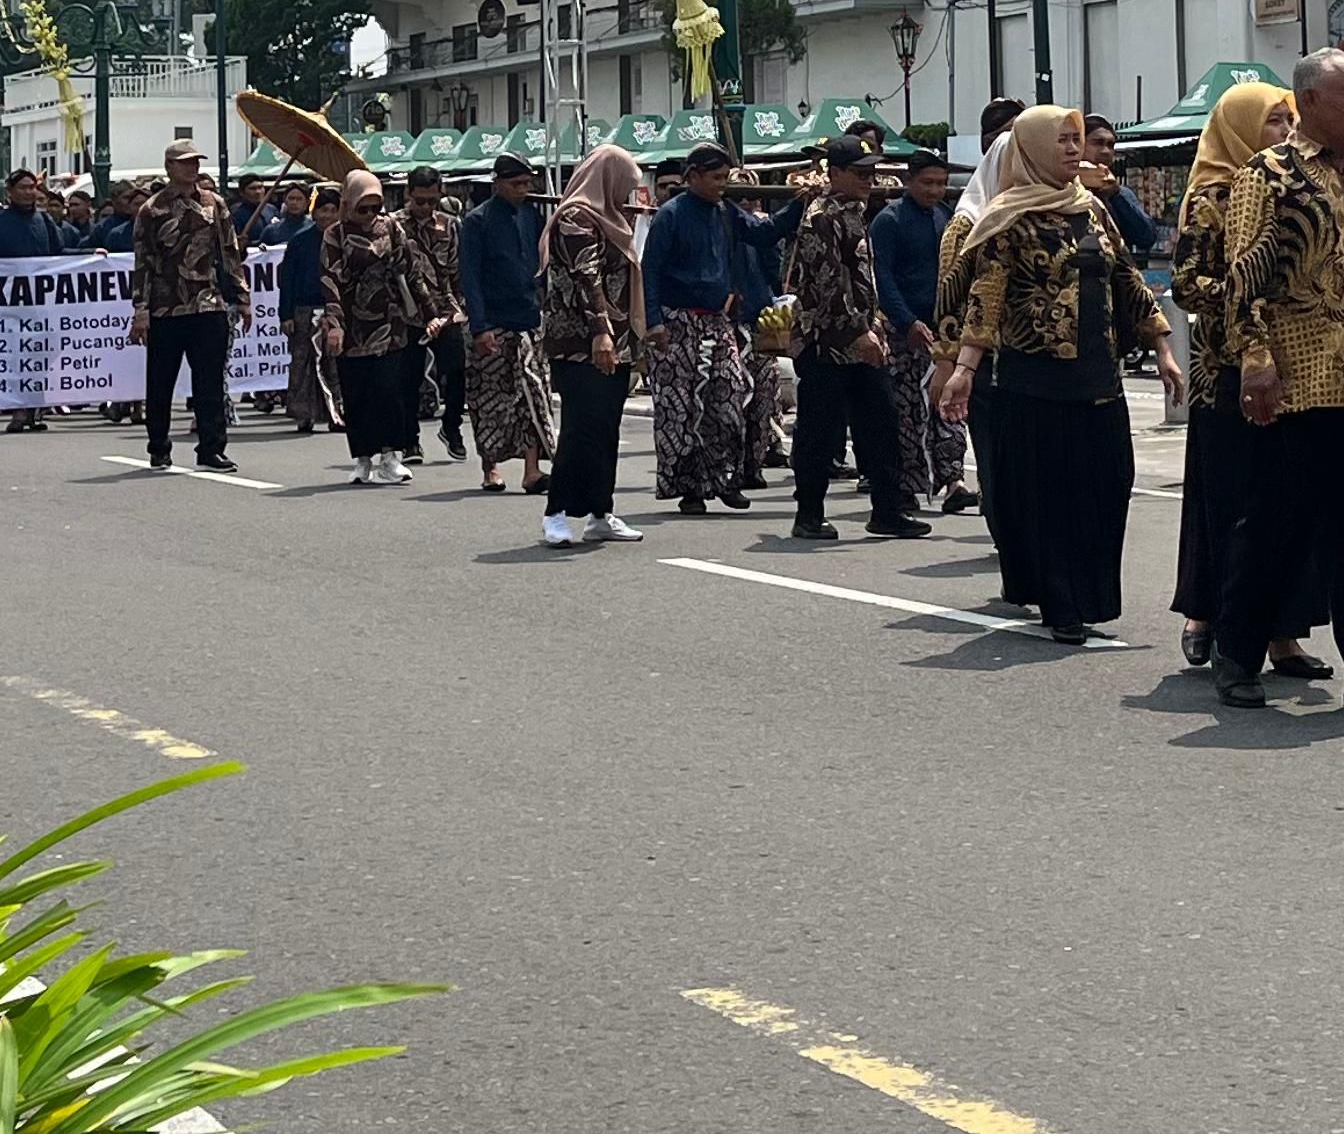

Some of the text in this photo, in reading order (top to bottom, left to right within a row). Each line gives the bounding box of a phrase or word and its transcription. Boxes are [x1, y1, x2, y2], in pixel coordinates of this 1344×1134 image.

[19, 318, 54, 333] Kal.
[19, 338, 54, 353] Kal.
[19, 357, 54, 373] Kal.
[61, 354, 102, 371] Petir
[19, 377, 54, 393] Kal.
[60, 373, 113, 390] Bohol
